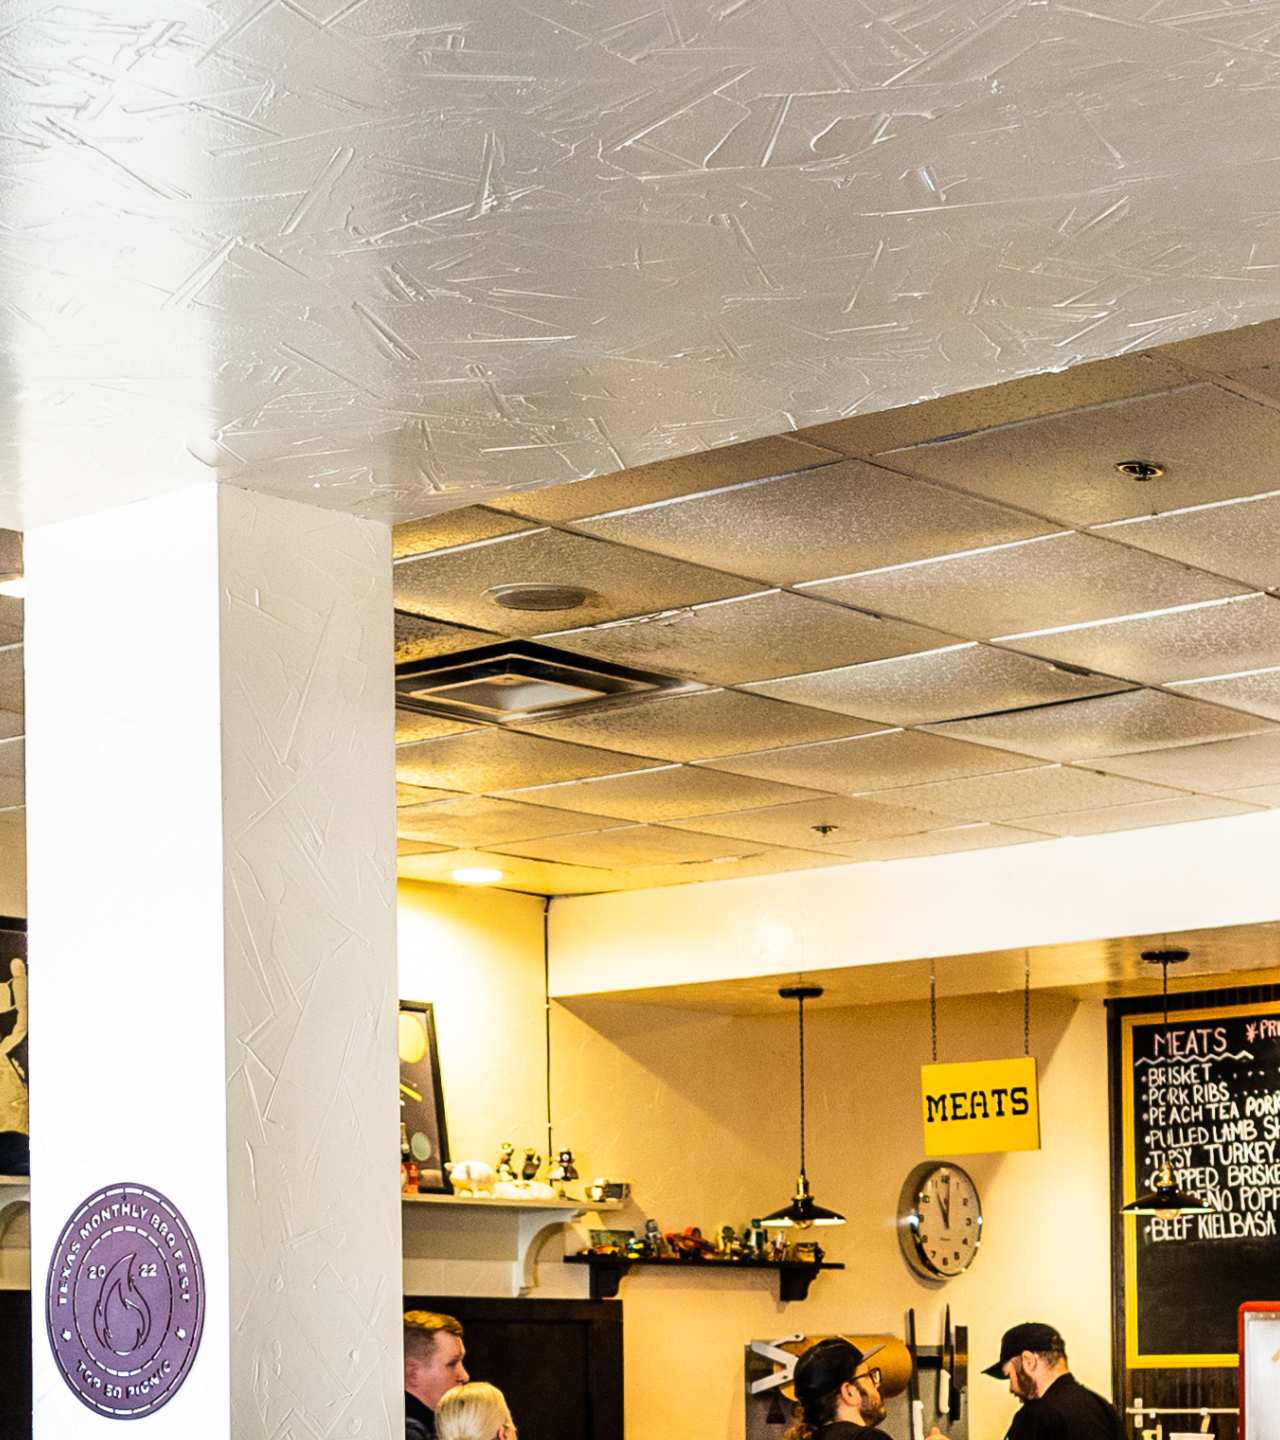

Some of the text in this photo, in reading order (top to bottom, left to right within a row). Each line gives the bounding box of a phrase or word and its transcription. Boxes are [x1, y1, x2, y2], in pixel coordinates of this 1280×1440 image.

[1154, 1027, 1227, 1056] MEATS
[1148, 1063, 1213, 1087] BRISKET
[926, 1087, 1029, 1123] MEATS
[1148, 1082, 1230, 1106] PORK RIBS
[1148, 1105, 1203, 1126] PEACH
[1205, 1101, 1240, 1121] TEA
[1149, 1127, 1209, 1149] PULLED
[1212, 1119, 1258, 1142] LAMB
[1149, 1147, 1192, 1169] TIPSY
[1203, 1141, 1276, 1167] TURKEY
[79, 1203, 149, 1240] MONTHLY
[149, 1215, 177, 1248] BBQ
[1151, 1215, 1194, 1242] BEEF
[1197, 1211, 1277, 1240] KIELBASA
[87, 1263, 157, 1280] 20 22
[104, 1384, 122, 1400] 50
[125, 1360, 172, 1400] PICNIC
